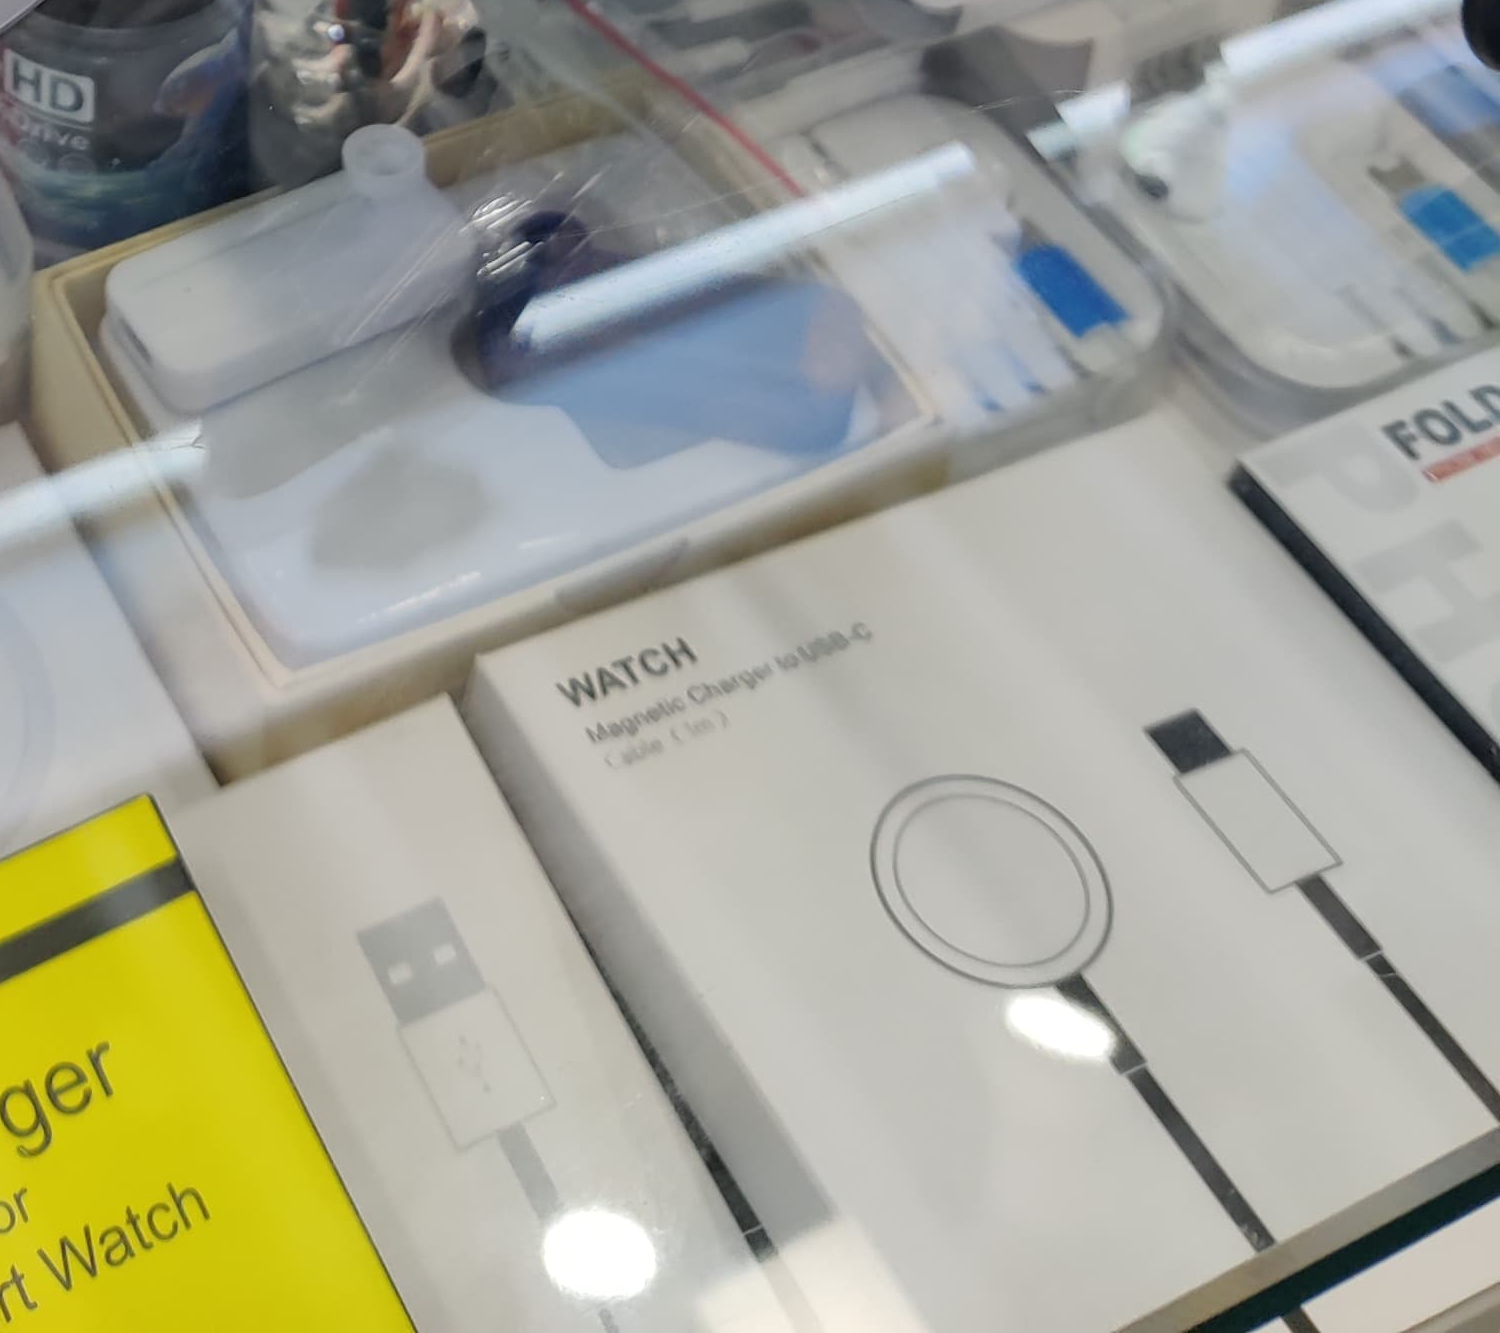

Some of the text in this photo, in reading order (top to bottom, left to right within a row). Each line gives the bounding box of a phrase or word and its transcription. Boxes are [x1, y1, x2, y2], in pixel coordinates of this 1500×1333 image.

[12, 59, 86, 114] HD
[556, 636, 698, 708] WATCH
[585, 696, 686, 744] Magnetic
[687, 662, 773, 706] Charger
[36, 1181, 211, 1292] Watch
